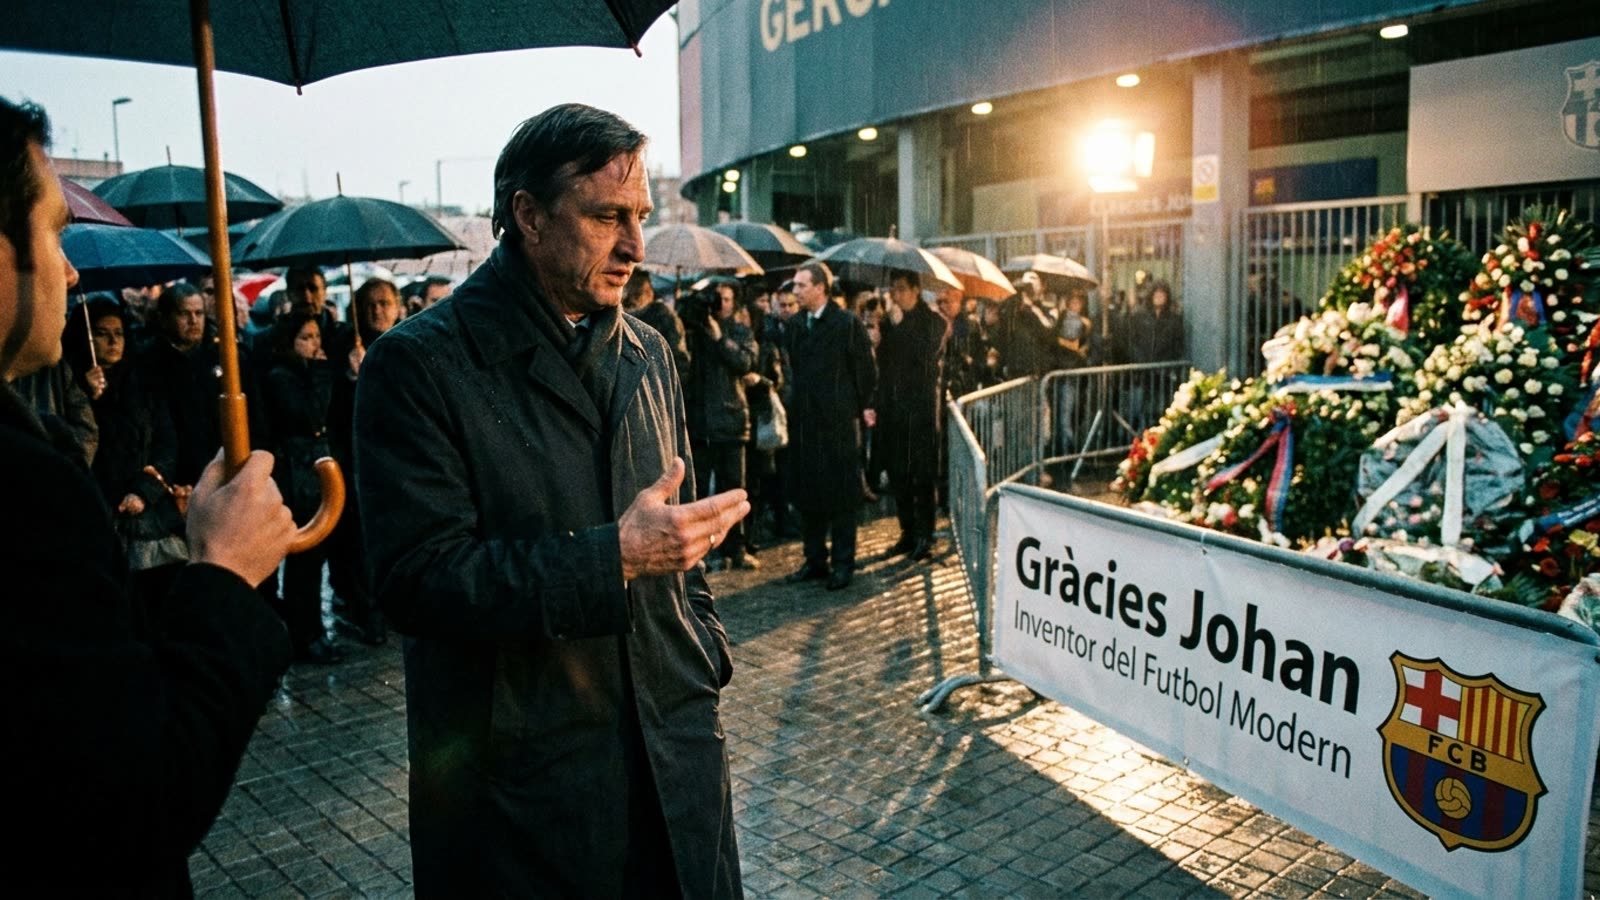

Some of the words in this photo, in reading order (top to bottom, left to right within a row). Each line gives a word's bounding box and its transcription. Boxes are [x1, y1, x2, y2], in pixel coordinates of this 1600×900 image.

[1014, 600, 1097, 663] Inventor
[1102, 637, 1136, 681] del
[1143, 652, 1223, 719] Futbol
[1230, 689, 1352, 779] Modern
[1015, 536, 1167, 638] Gràcies
[1179, 589, 1361, 715] Johan
[1428, 734, 1487, 773] FCB
